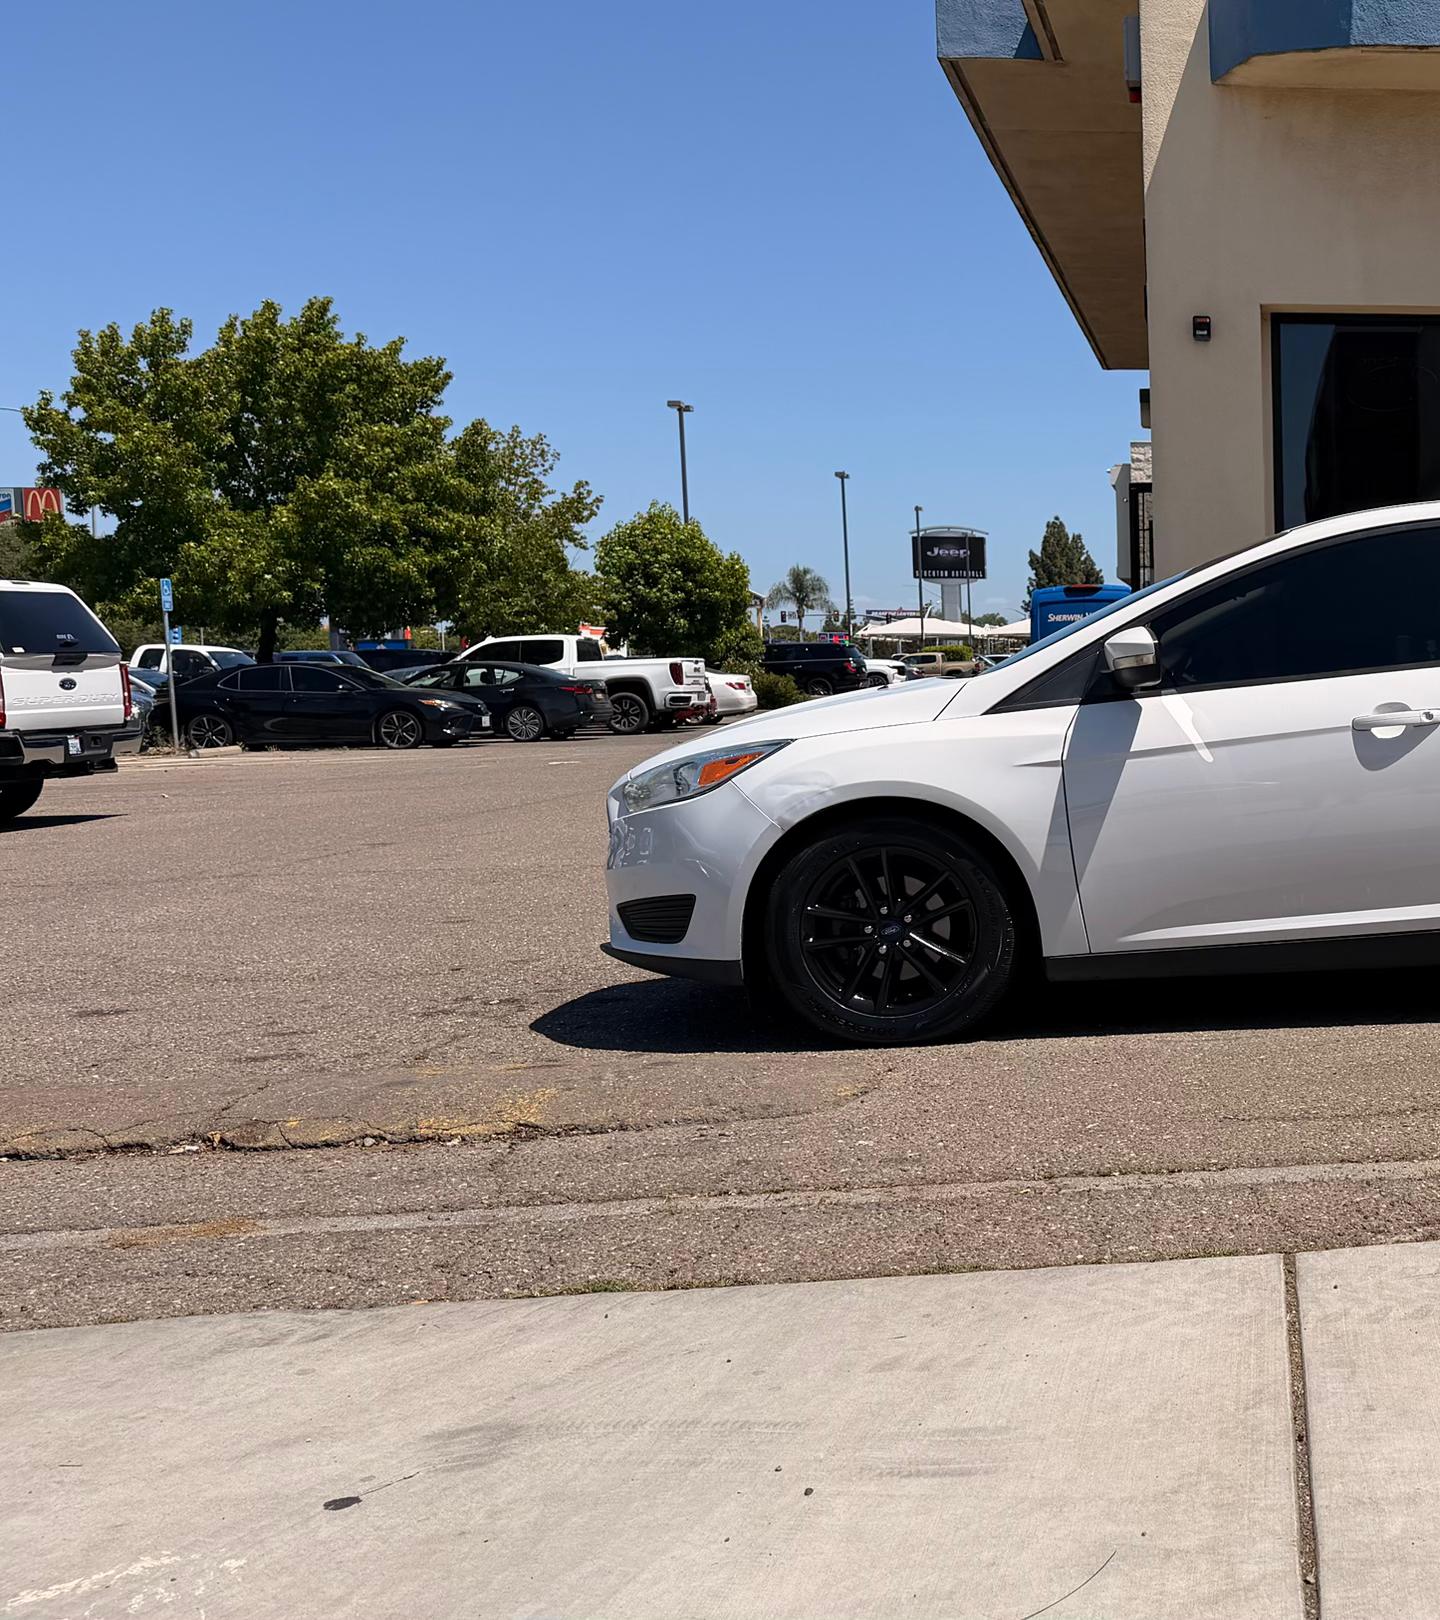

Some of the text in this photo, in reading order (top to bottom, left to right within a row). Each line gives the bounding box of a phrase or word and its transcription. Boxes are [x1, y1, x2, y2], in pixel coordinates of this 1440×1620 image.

[926, 547, 970, 558] Jeep
[1048, 613, 1083, 622] SHERWIN
[12, 693, 118, 706] SUPER DUTY
